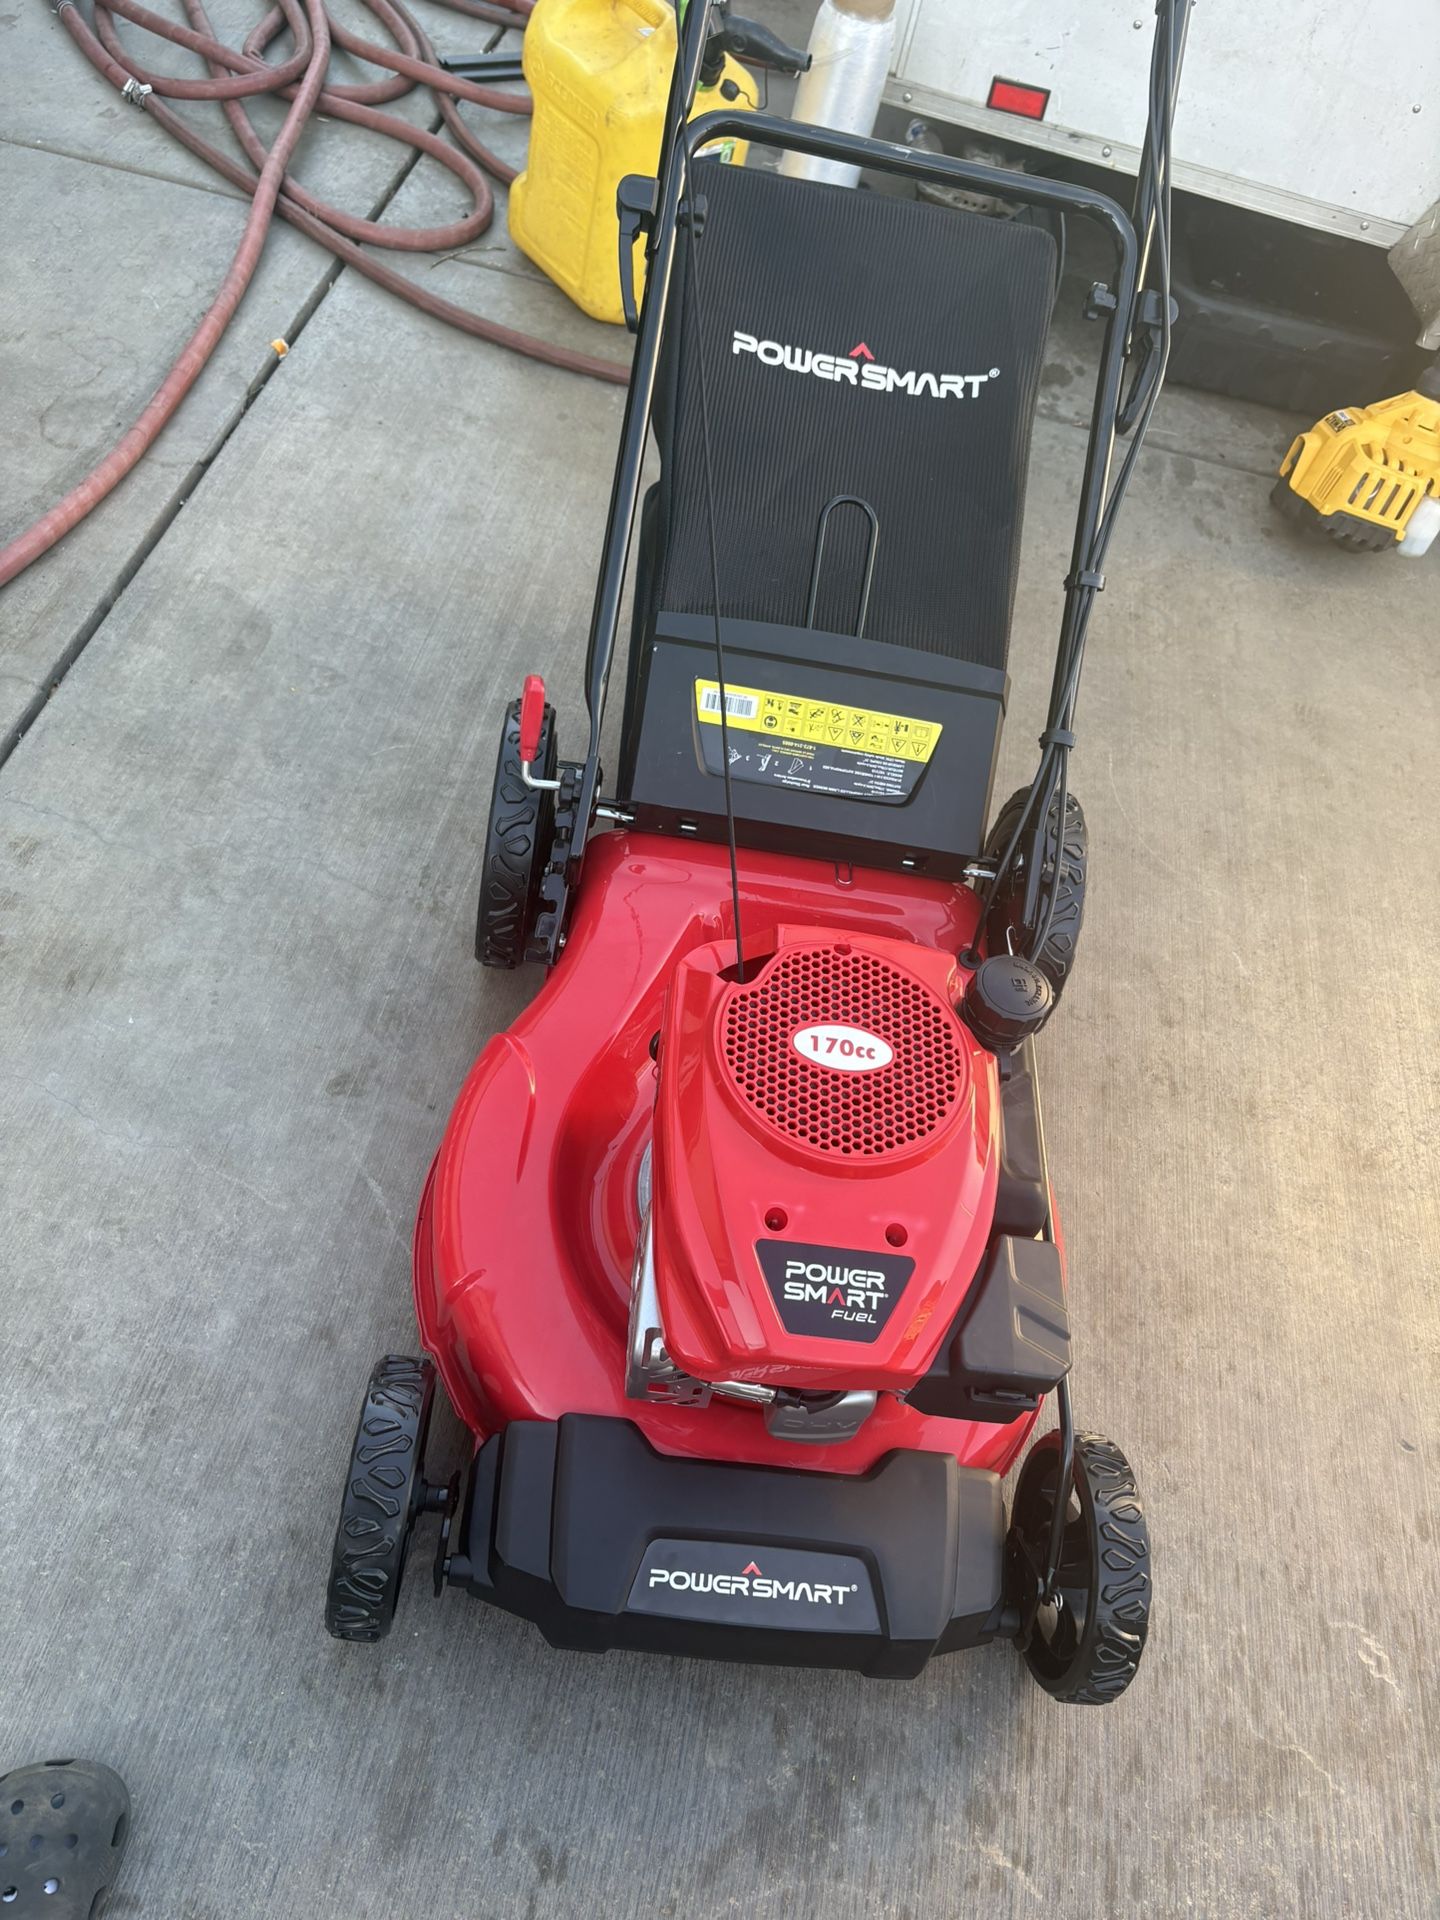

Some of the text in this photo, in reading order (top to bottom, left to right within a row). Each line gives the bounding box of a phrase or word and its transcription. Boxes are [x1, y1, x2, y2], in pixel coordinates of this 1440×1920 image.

[810, 1035, 876, 1060] 170cc
[785, 1260, 886, 1290] POWER
[783, 1281, 889, 1310] SMART
